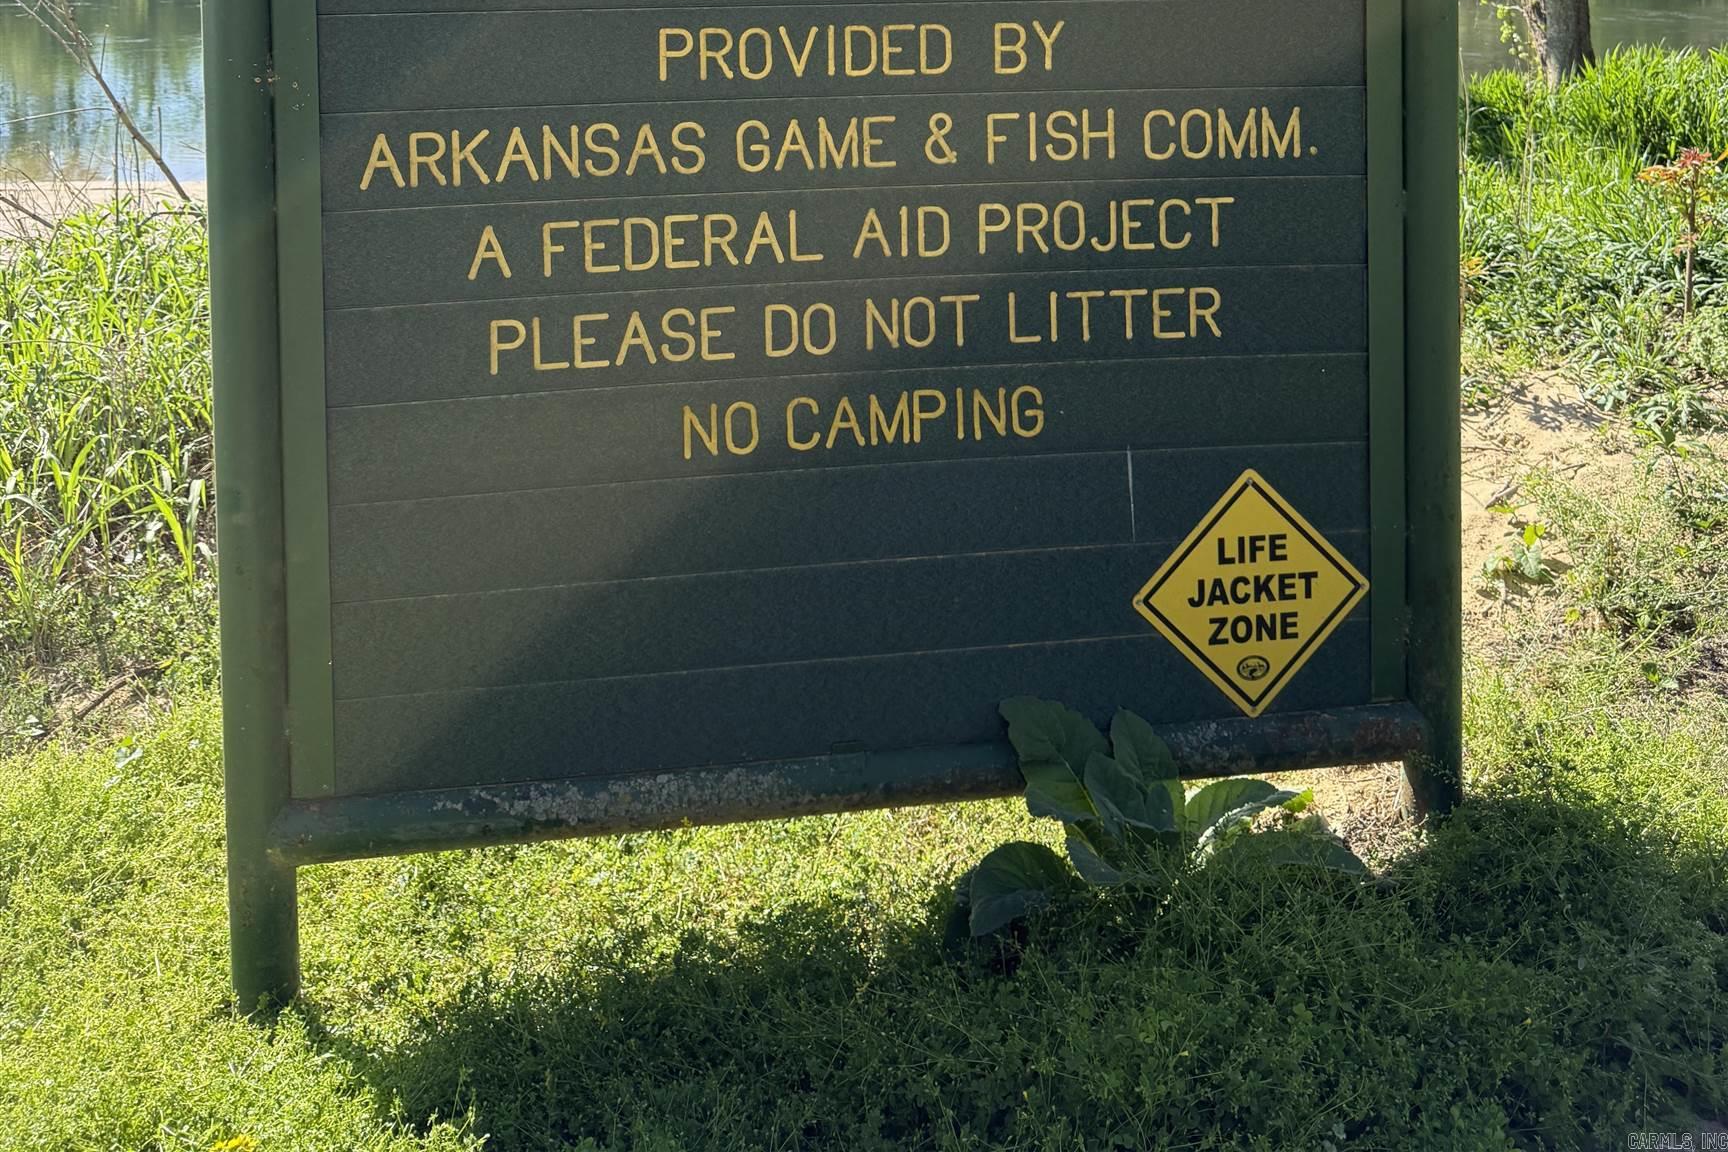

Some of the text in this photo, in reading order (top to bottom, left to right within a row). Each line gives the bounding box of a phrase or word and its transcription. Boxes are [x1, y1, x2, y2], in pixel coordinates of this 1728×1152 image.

[659, 21, 1062, 80] PROVIDED BY
[361, 108, 1320, 189] ARKANSAS GAME & FISH COMM.
[468, 197, 1232, 279] A FEDERAL AID PROJECT
[490, 288, 1219, 374] PLEASE DO NOT LITTER
[683, 386, 1043, 459] NO CAMPING
[1217, 534, 1287, 565] LIFE
[1188, 572, 1318, 607] JACKET
[1208, 612, 1299, 645] ZONE
